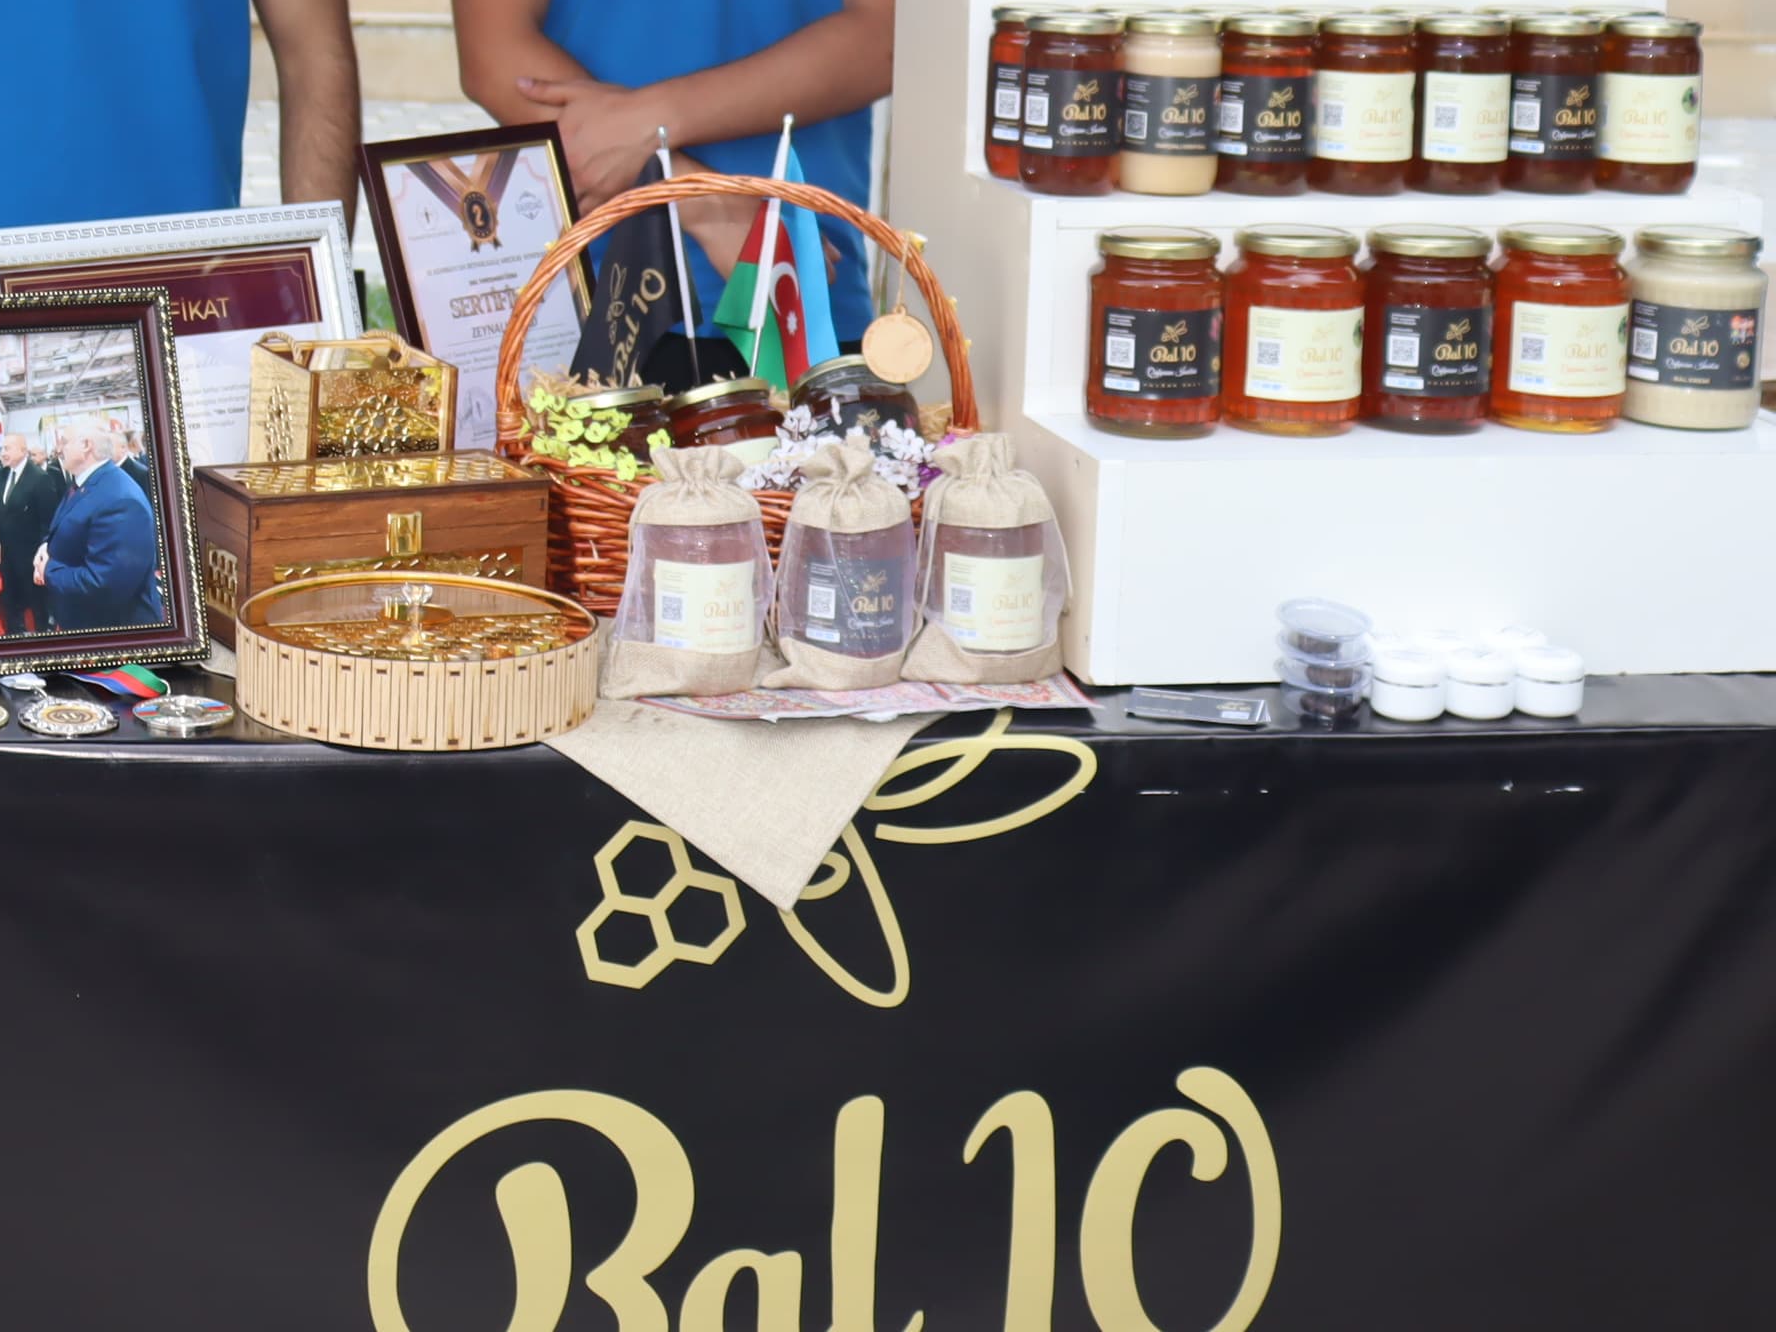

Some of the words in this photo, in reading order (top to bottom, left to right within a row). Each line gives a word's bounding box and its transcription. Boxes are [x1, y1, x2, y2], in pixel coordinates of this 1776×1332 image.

[1555, 109, 1581, 126] Bal
[1583, 108, 1597, 125] 10
[1150, 345, 1179, 362] Bal
[1181, 344, 1196, 362] 10
[1435, 343, 1462, 360] Bal
[1464, 342, 1478, 359] 10
[1670, 337, 1699, 355] Bal
[1702, 339, 1719, 356] 10
[367, 1089, 924, 1332] Bal
[962, 1066, 1283, 1332] 10
